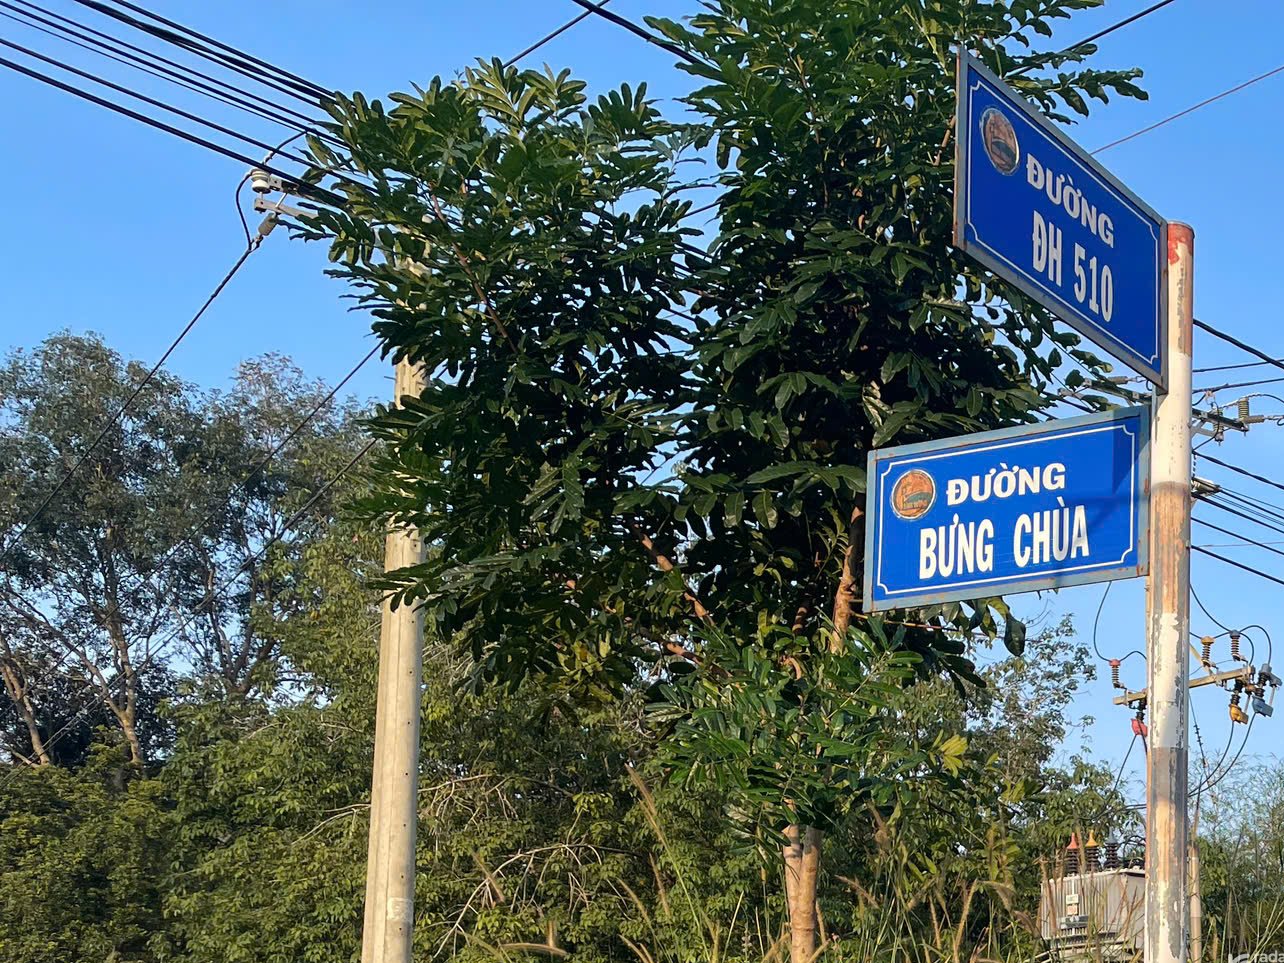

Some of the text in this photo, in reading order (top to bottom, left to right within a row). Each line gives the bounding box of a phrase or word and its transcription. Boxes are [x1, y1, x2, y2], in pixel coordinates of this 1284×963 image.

[1026, 152, 1114, 248] ĐƯỜNG
[1032, 210, 1113, 322] ĐH 510
[946, 462, 1066, 506] ĐƯỜNG
[919, 496, 1090, 580] BƯNG CHÙA
